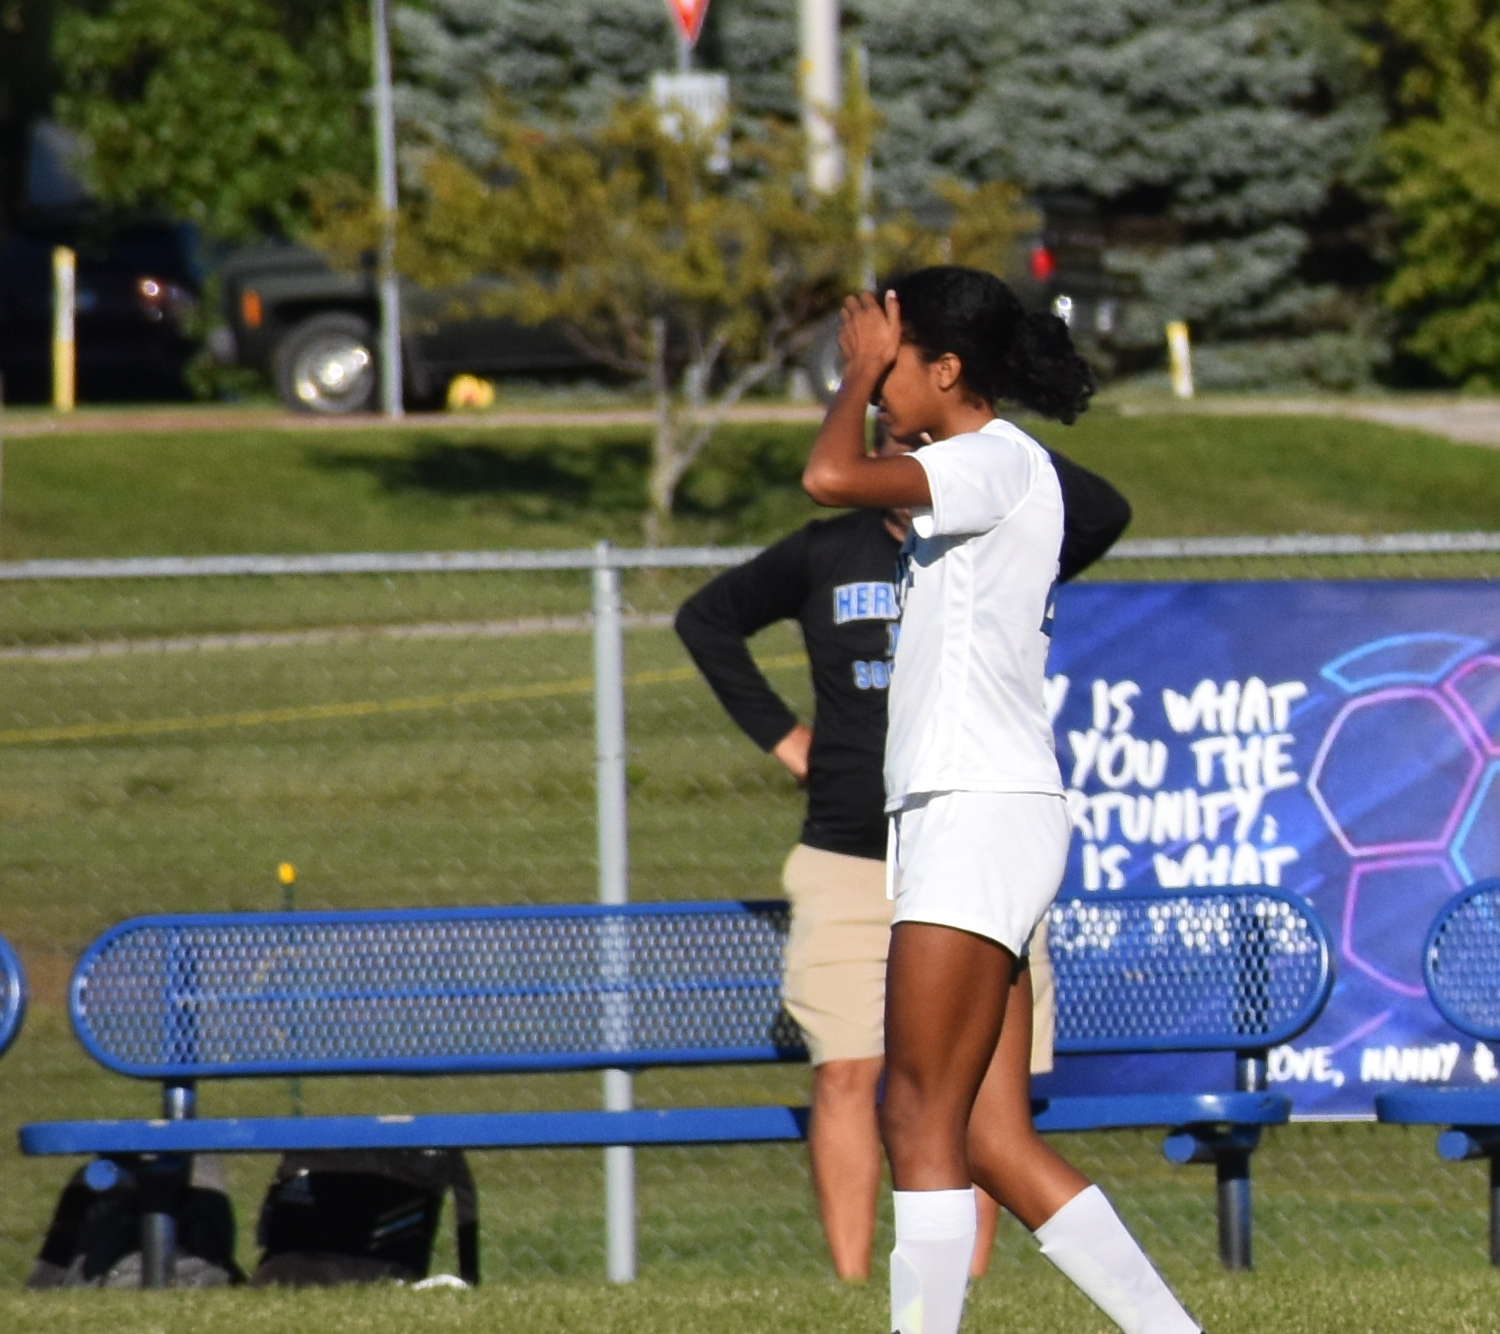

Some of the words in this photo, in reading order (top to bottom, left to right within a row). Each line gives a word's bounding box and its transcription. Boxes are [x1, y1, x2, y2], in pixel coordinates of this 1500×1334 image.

[834, 581, 900, 623] HER
[1091, 679, 1141, 734] IS
[1162, 676, 1308, 734] WHAT
[1068, 728, 1168, 789] YOU
[1190, 732, 1300, 789] THE
[1066, 785, 1279, 845] RTUNITY;
[1083, 843, 1131, 891] IS
[1153, 842, 1299, 889] WHAT
[1360, 1041, 1460, 1082] NANNY
